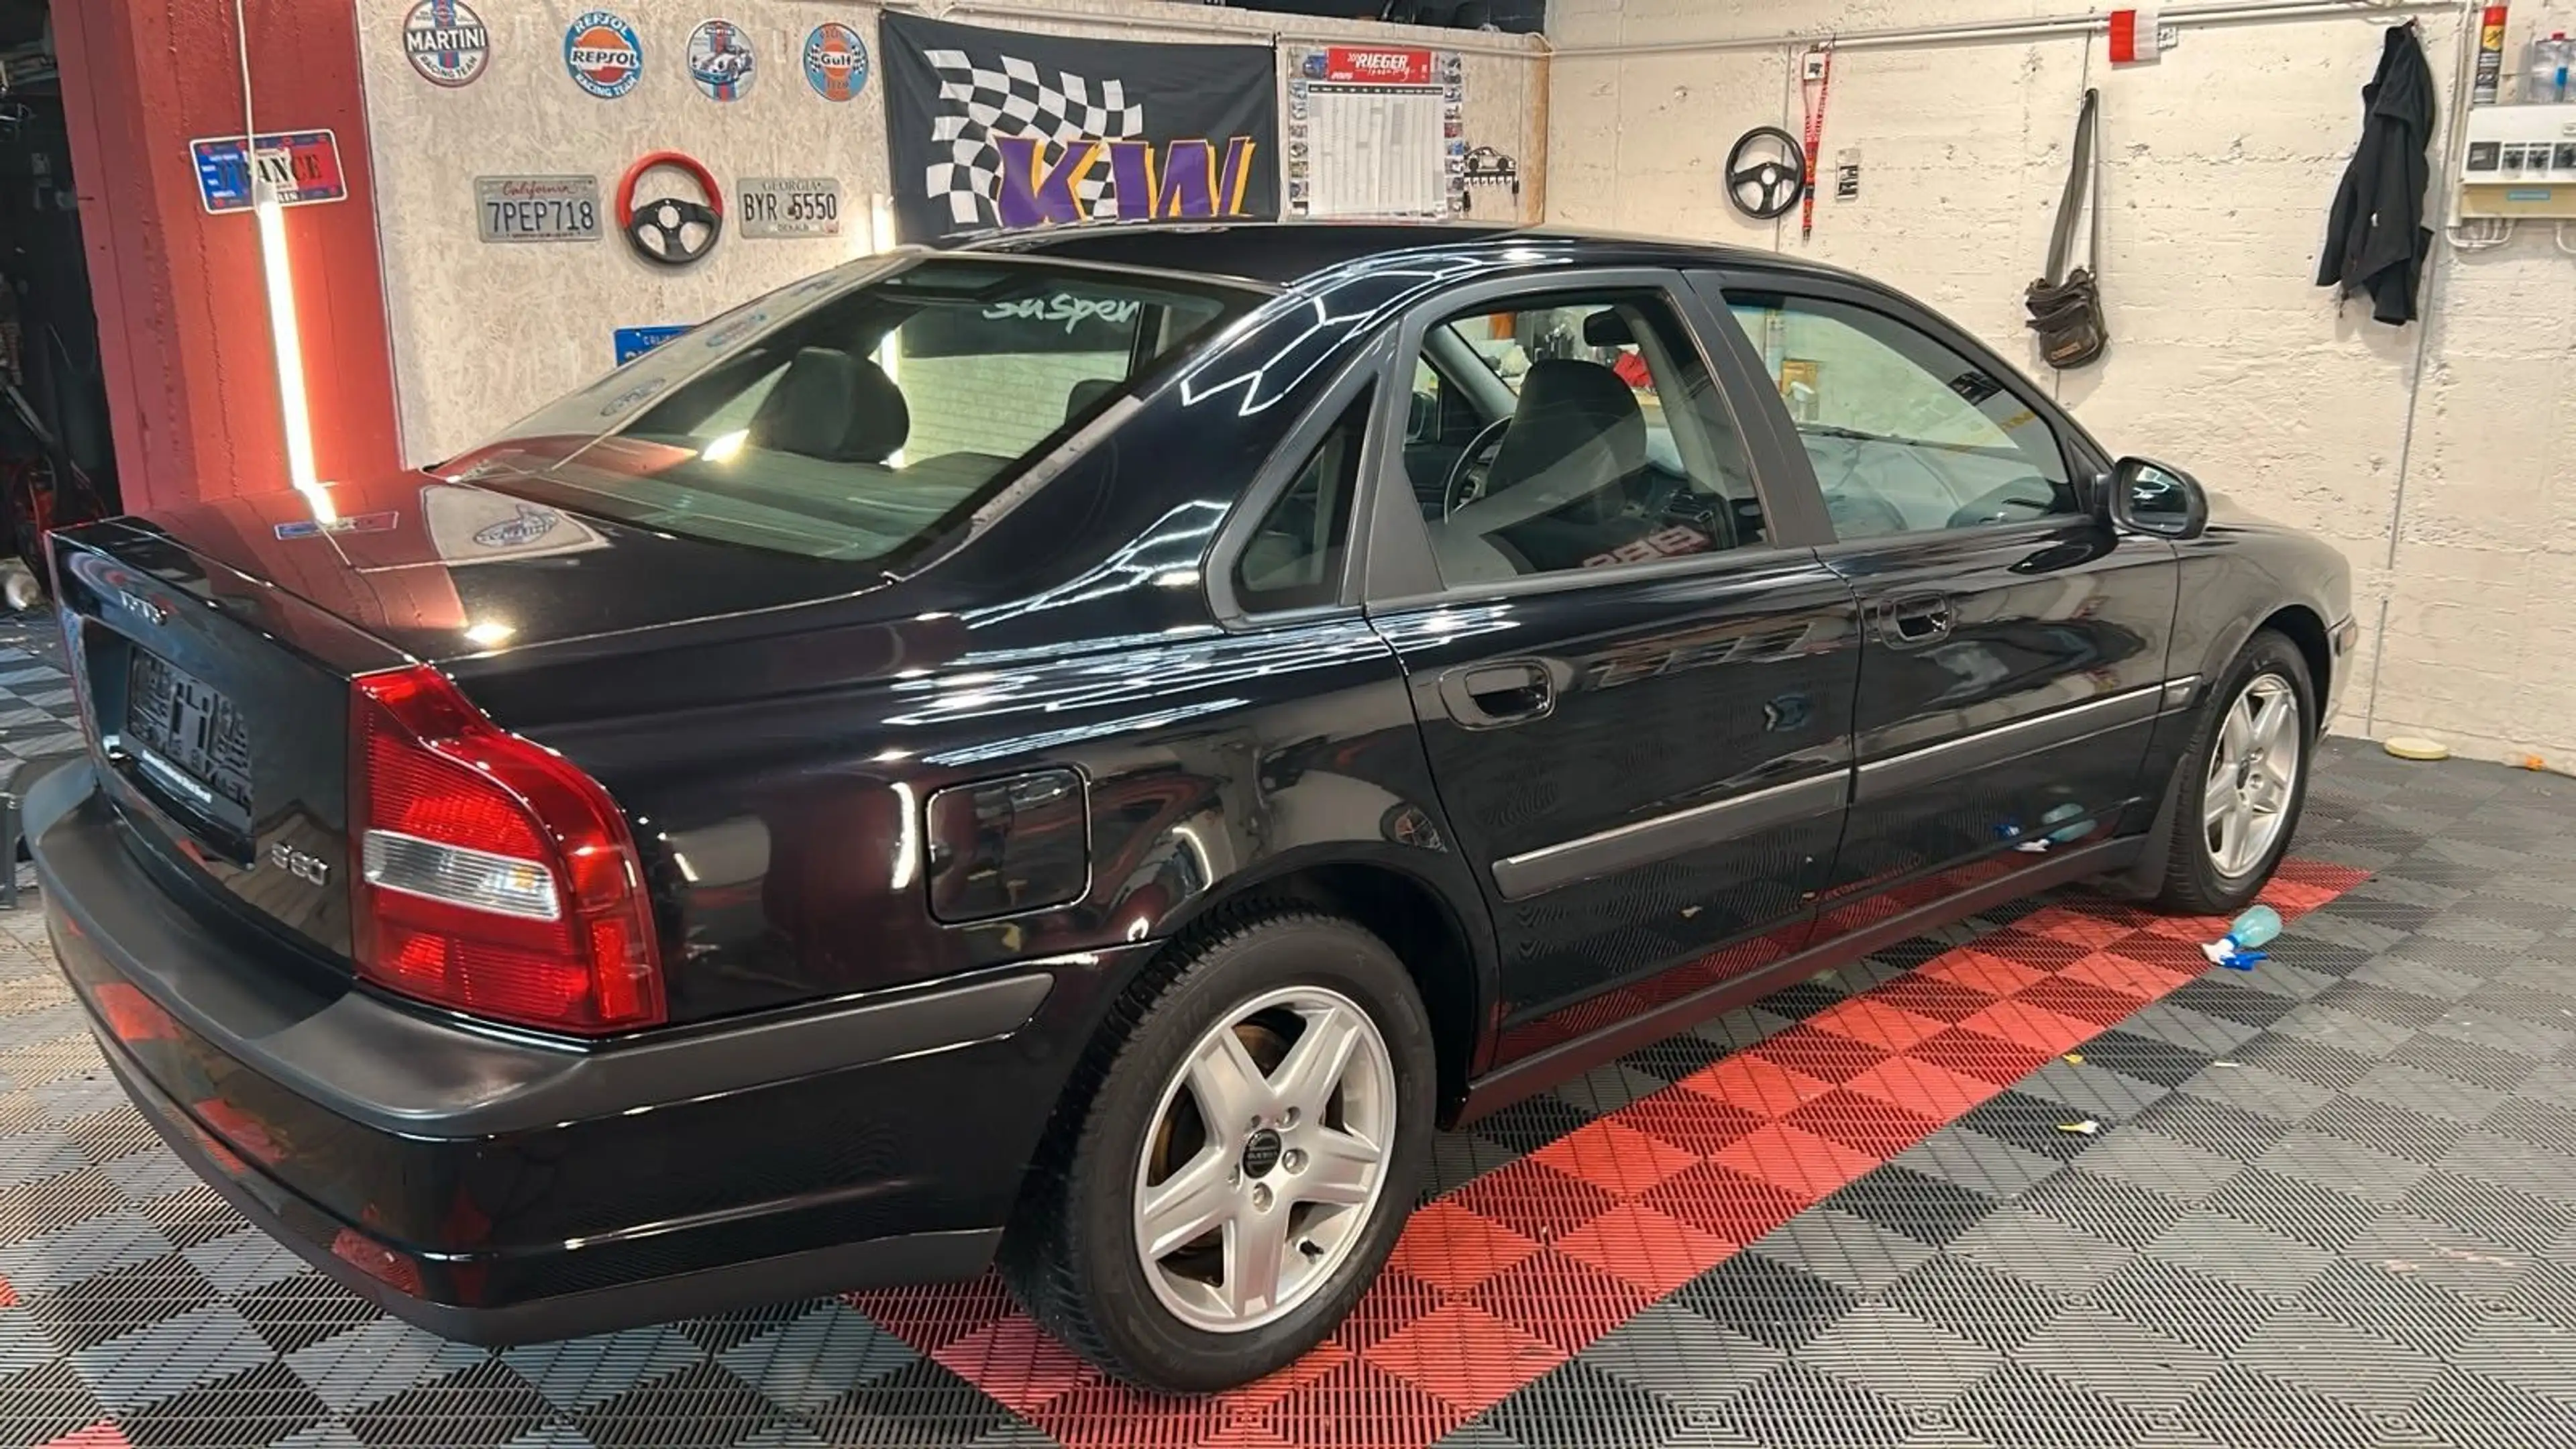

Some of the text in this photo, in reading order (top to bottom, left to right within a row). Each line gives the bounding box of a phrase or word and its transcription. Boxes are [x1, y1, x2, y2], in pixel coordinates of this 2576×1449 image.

[575, 13, 629, 36] REPSOL
[407, 28, 486, 52] MARTINI
[572, 50, 636, 66] REPSOL
[820, 53, 852, 66] Gulf
[1355, 52, 1409, 69] RIEGER
[503, 180, 578, 200] California
[762, 182, 818, 192] GEORGIA
[989, 133, 1257, 227] KW
[487, 201, 594, 232] 7PEP718
[744, 193, 837, 221] BYR 5550
